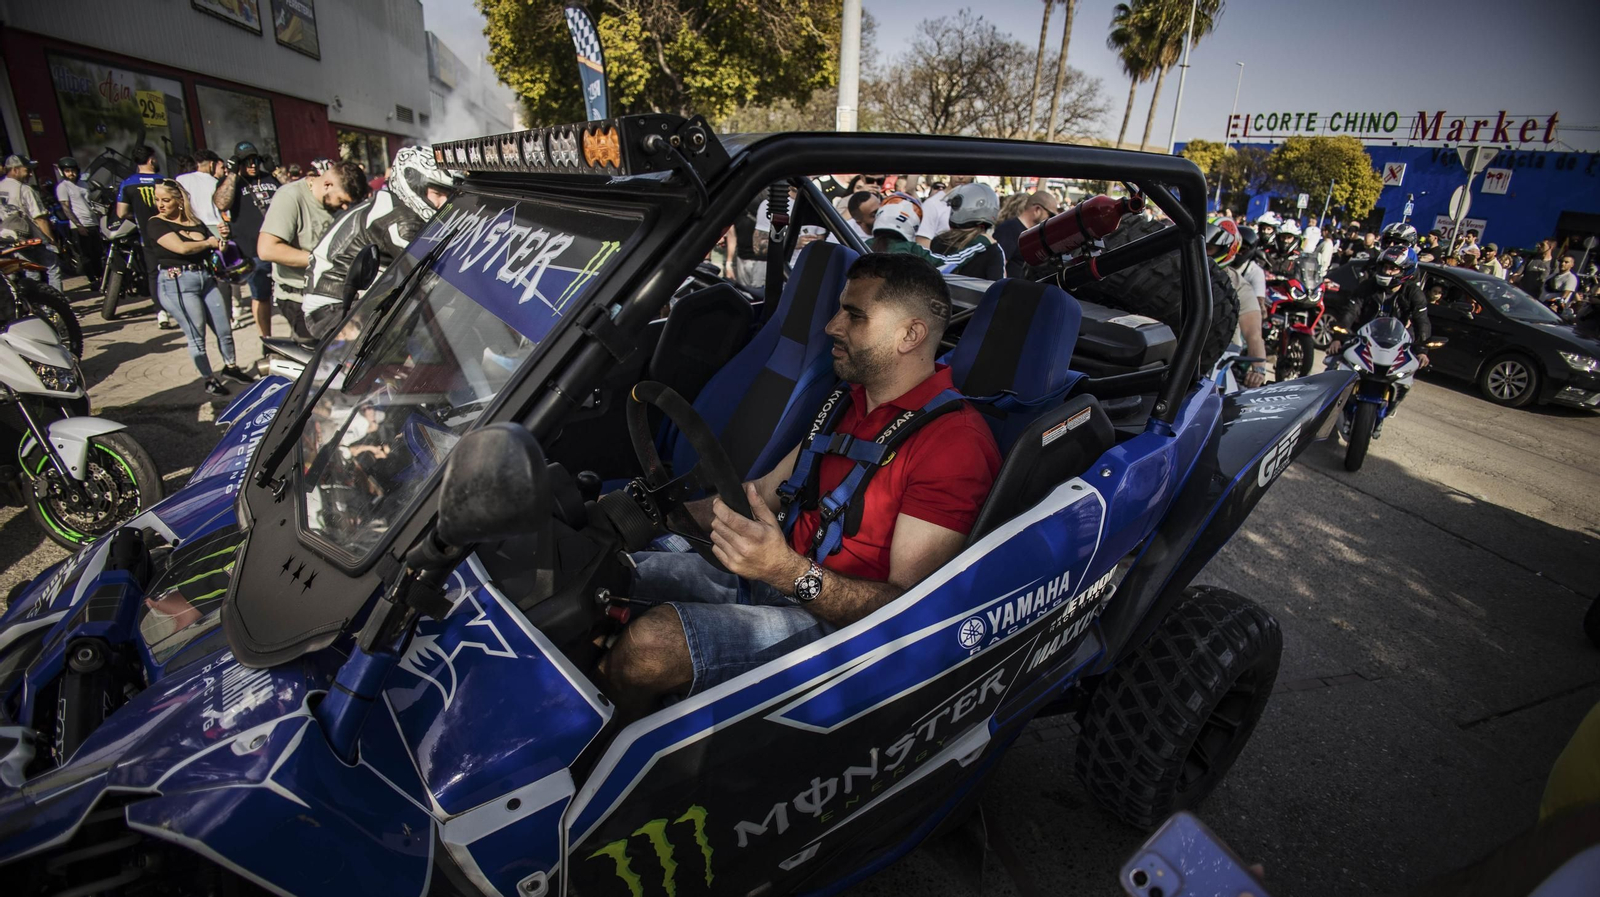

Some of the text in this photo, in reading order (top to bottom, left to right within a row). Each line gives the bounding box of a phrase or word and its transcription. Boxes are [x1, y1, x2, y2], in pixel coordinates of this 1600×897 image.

[1253, 111, 1318, 132] CORTE
[1329, 110, 1399, 133] CHINO
[1411, 110, 1560, 144] Market
[429, 204, 576, 304] MONSTER
[808, 389, 843, 441] KYOSTAR
[969, 599, 1062, 656] RACING
[986, 570, 1070, 635] YAMAHA
[201, 663, 217, 732] RACING
[734, 668, 1006, 848] MONSTER
[821, 735, 949, 824] ENERGY
